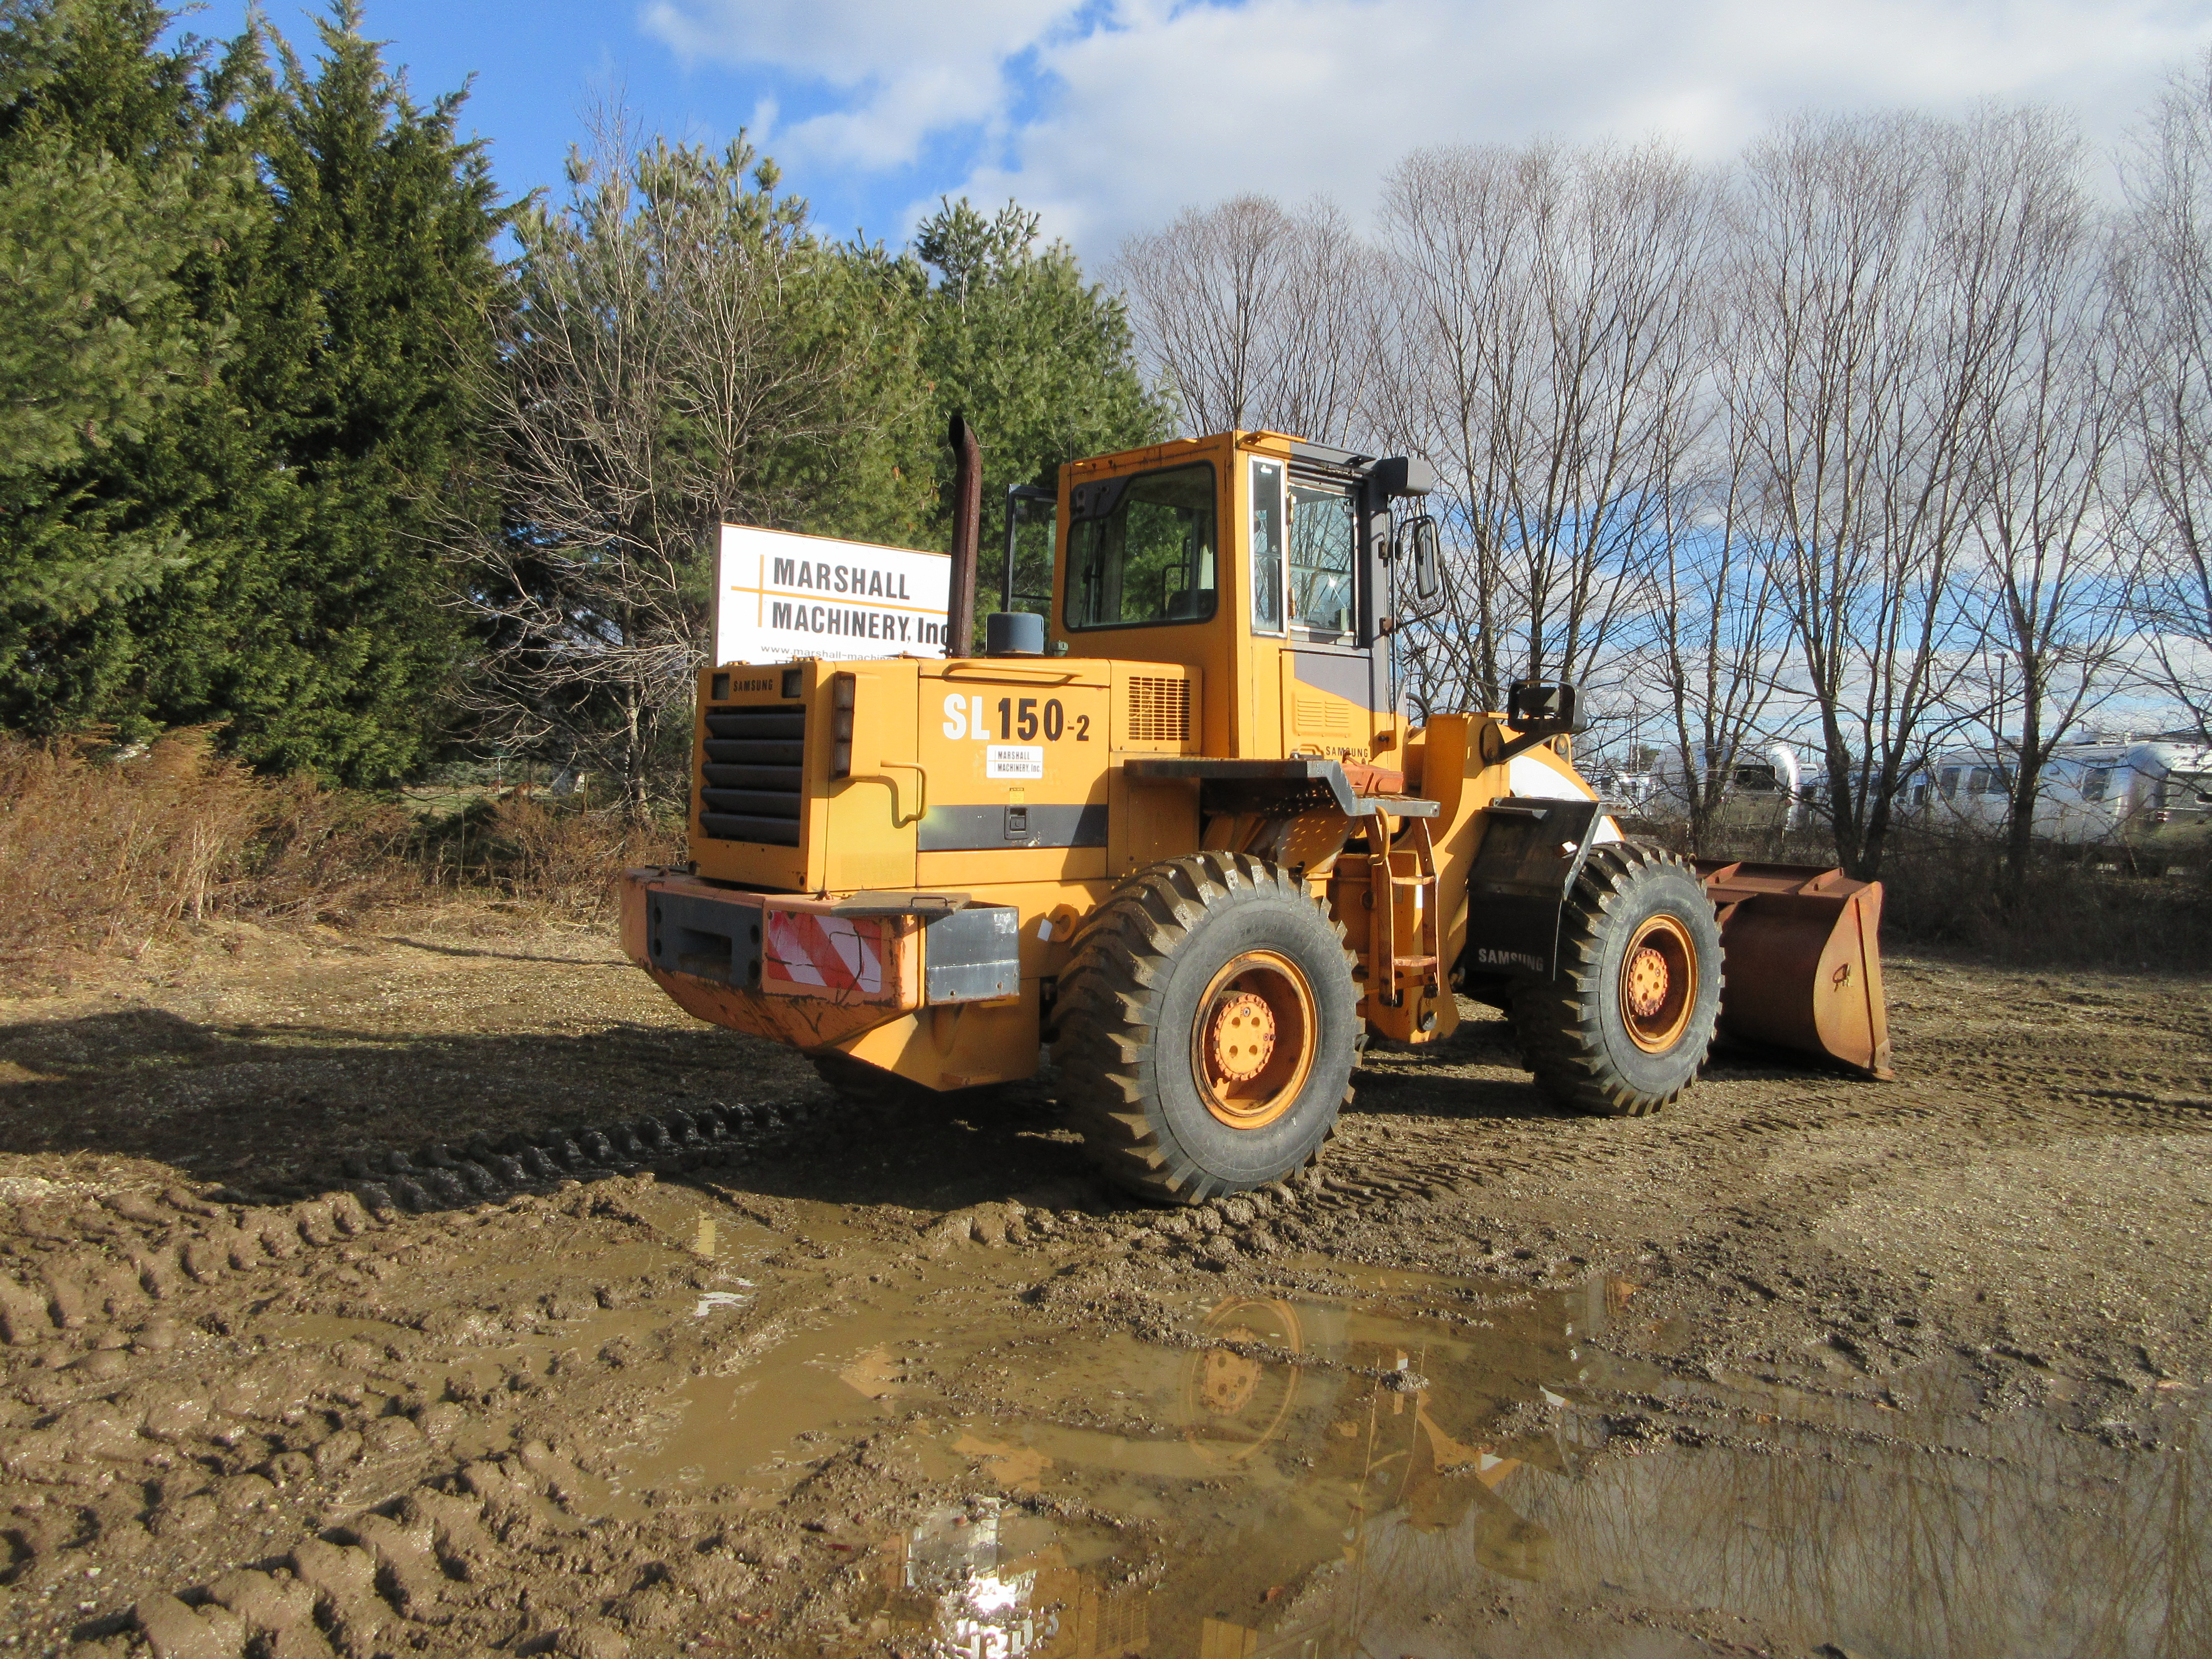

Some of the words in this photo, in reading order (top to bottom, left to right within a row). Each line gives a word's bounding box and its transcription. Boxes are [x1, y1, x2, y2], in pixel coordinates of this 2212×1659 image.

[774, 557, 910, 600] MARSHALL
[772, 602, 911, 644] MACHINERY,
[733, 679, 773, 692] SAMSUNG
[943, 693, 990, 739] SL
[997, 763, 1030, 773] MACHINERY,
[1031, 764, 1041, 772] Inc.
[998, 751, 1030, 760] MARSHALL
